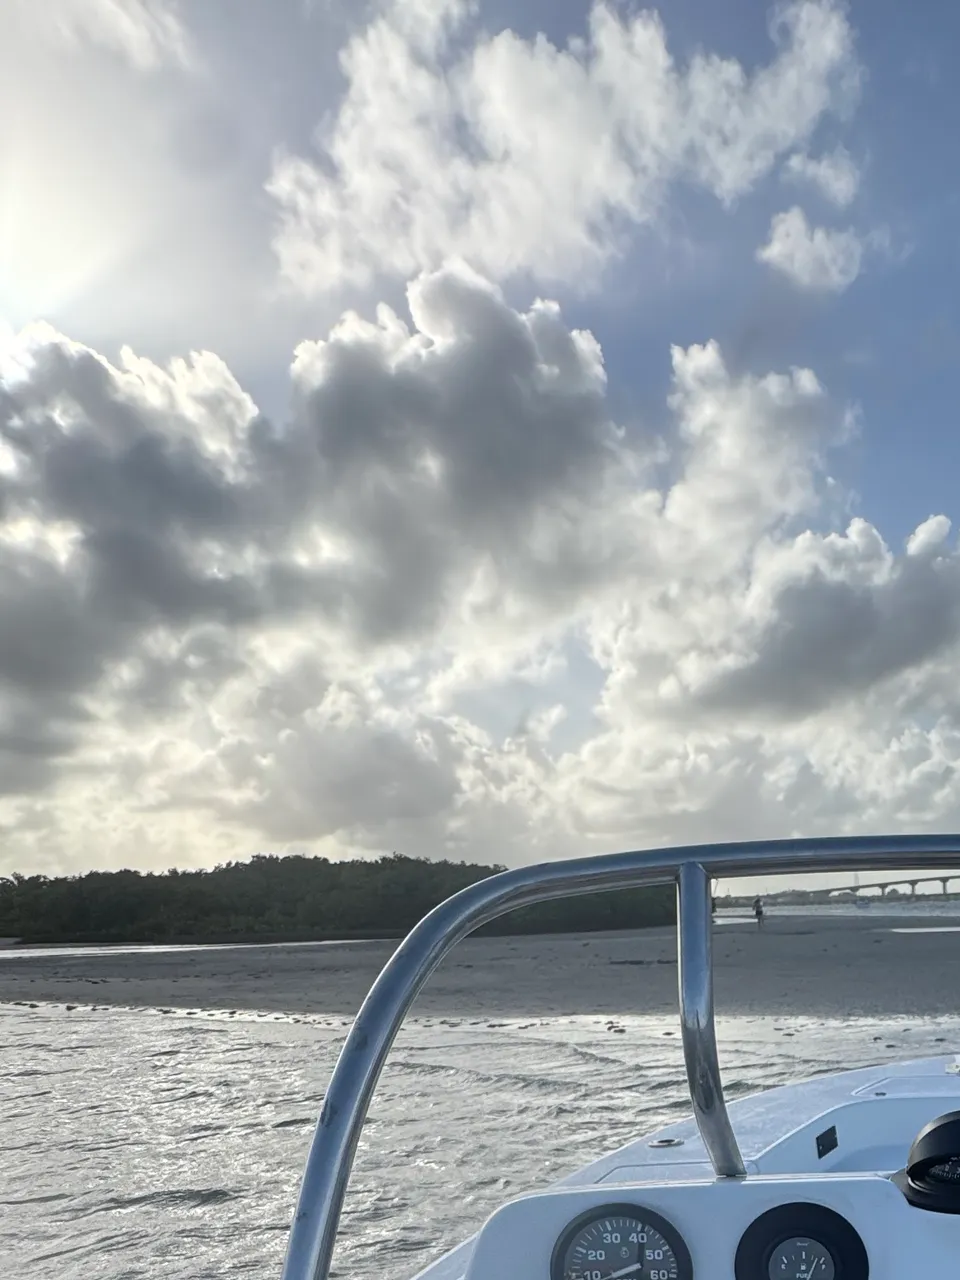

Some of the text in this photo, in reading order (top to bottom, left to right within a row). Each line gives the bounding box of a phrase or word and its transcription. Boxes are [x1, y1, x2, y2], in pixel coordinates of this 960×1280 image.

[602, 1232, 620, 1243] 30
[628, 1232, 647, 1243] 40
[588, 1250, 606, 1260] 20
[646, 1250, 664, 1260] 50
[584, 1270, 601, 1280] 10
[650, 1270, 668, 1280] 60
